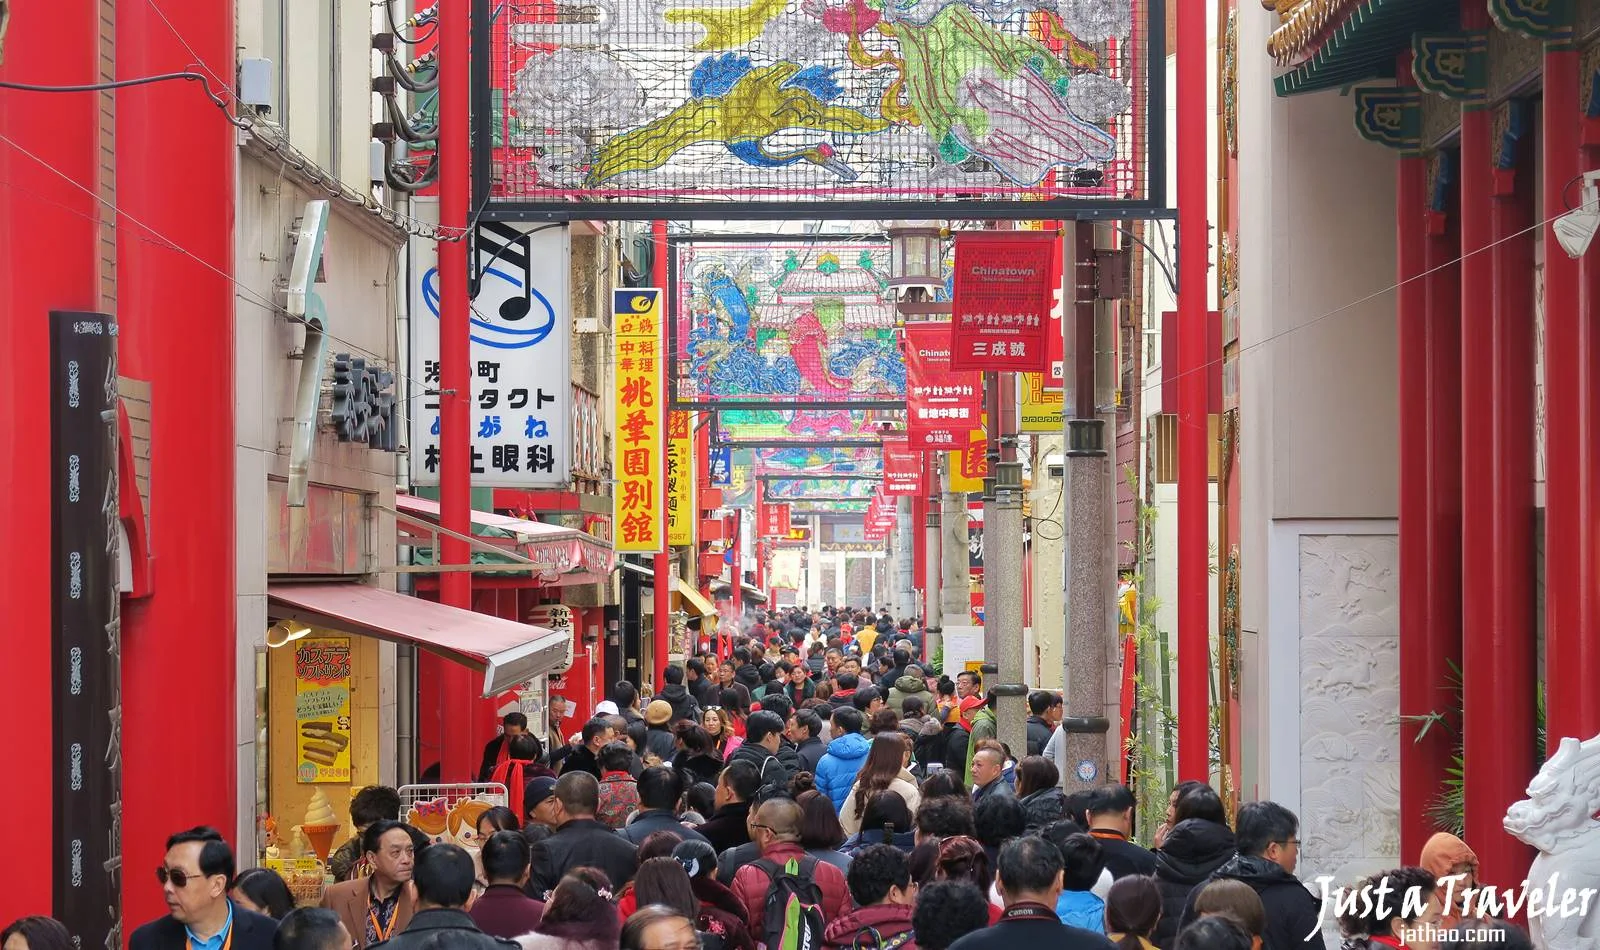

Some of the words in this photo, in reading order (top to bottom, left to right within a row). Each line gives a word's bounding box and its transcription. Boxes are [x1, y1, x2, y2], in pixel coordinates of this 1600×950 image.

[972, 266, 1035, 276] Chinatown
[620, 341, 634, 373] 中華
[639, 341, 654, 373] 料理
[919, 349, 951, 358] Chinat
[972, 341, 1026, 357] 三成號
[424, 360, 500, 383] 浜町
[424, 388, 555, 410] コタクト
[550, 607, 570, 632] 新地
[296, 648, 350, 664] カステラ
[296, 664, 350, 680] ソフトサンド
